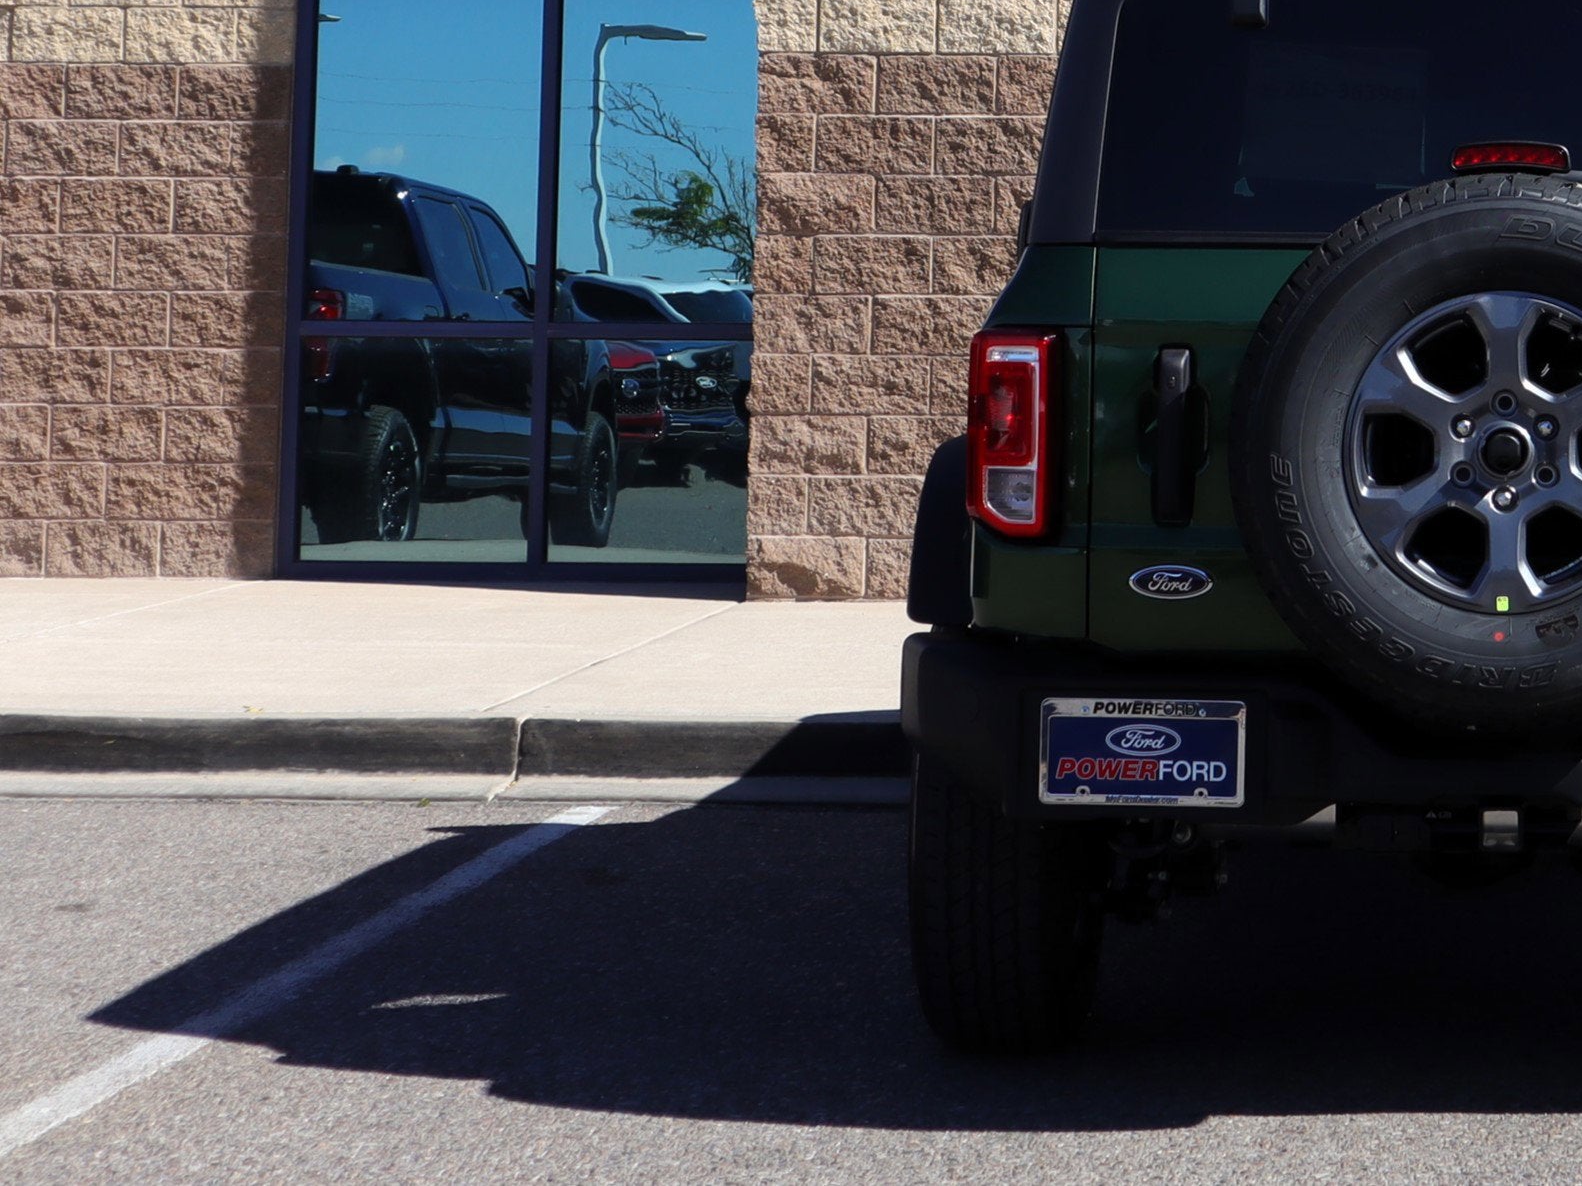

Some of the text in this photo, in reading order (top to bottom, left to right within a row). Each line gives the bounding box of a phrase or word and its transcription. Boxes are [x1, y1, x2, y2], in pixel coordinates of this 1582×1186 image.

[1269, 452, 1560, 689] BRIDGESTONE
[1148, 571, 1193, 592] Ford
[1092, 701, 1199, 717] POWERFORD
[1120, 729, 1165, 750] Ford
[1055, 757, 1228, 783] POWERFORD
